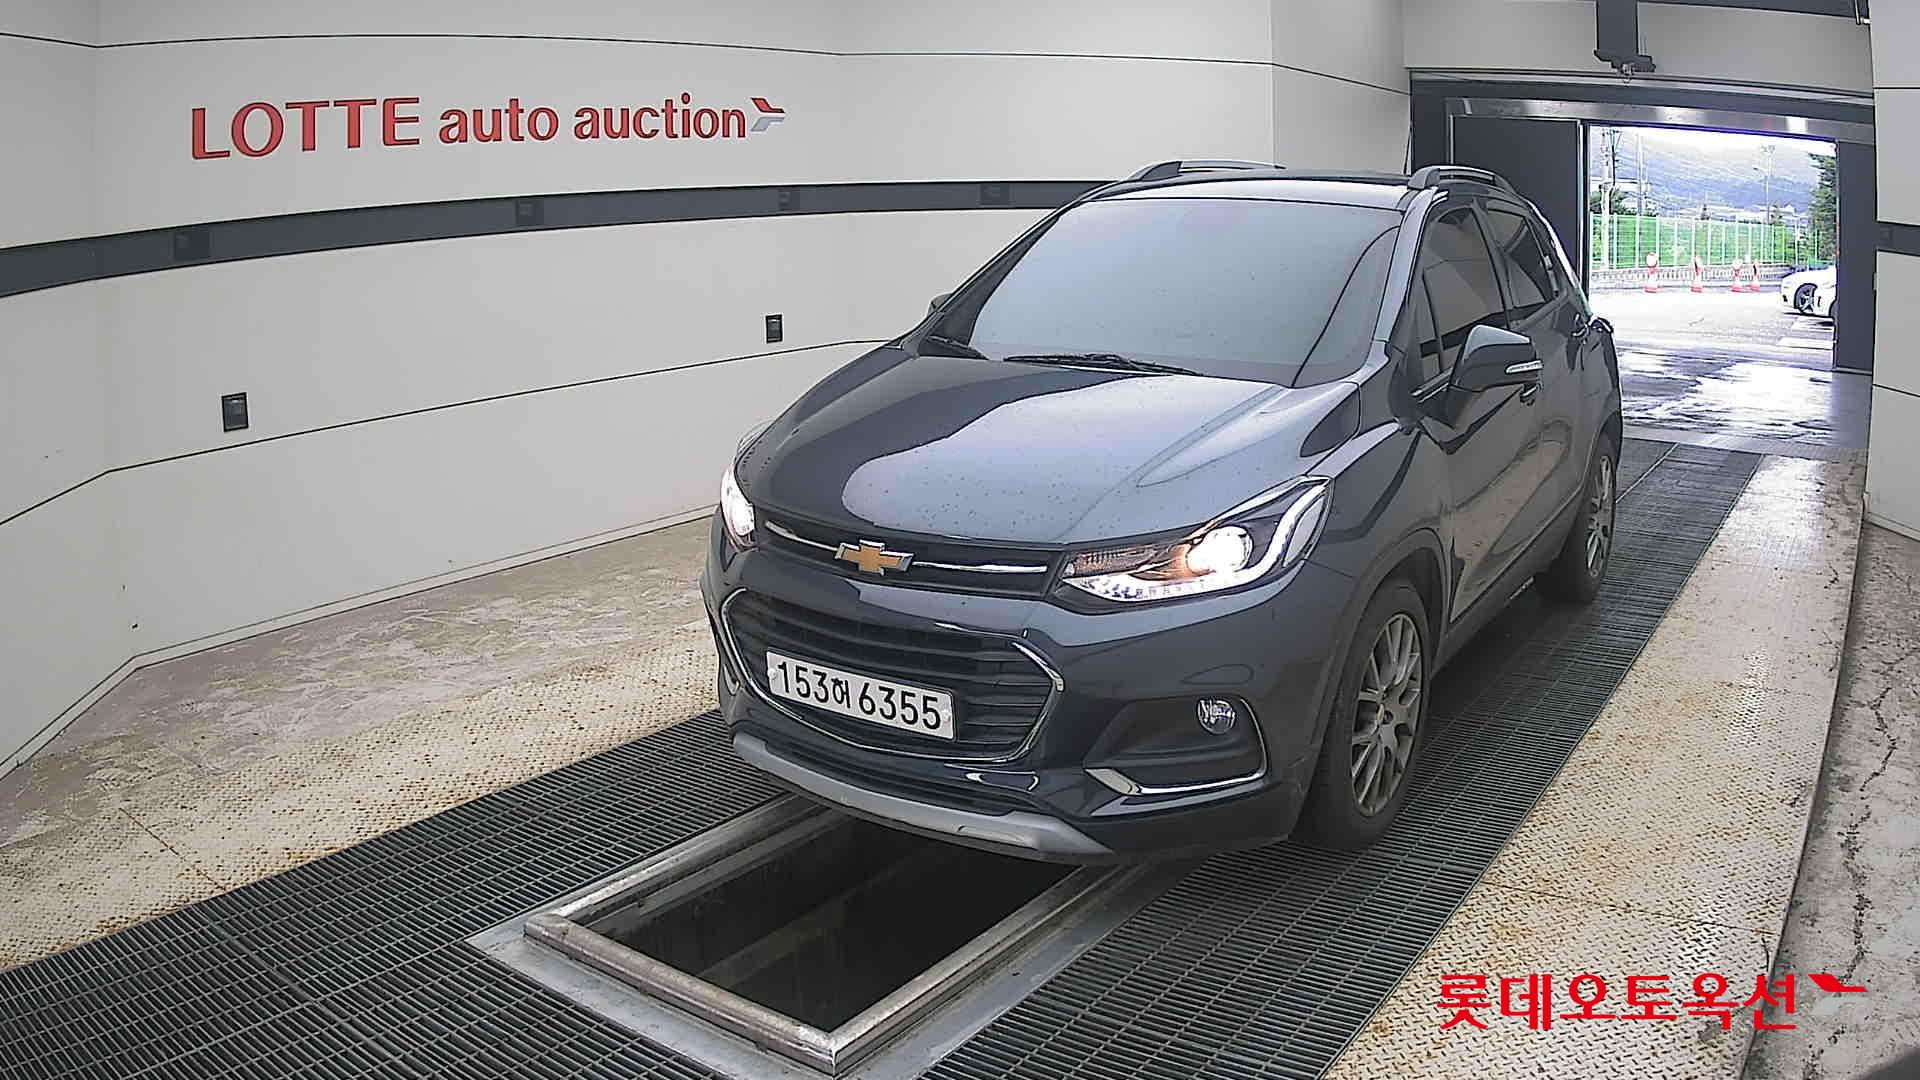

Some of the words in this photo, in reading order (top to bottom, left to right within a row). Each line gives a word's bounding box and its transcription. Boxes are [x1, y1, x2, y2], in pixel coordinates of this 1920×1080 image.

[192, 97, 419, 160] LOTTE
[439, 98, 559, 144] auto
[574, 92, 747, 140] auction
[778, 661, 851, 709] 153허
[858, 682, 941, 730] 6355
